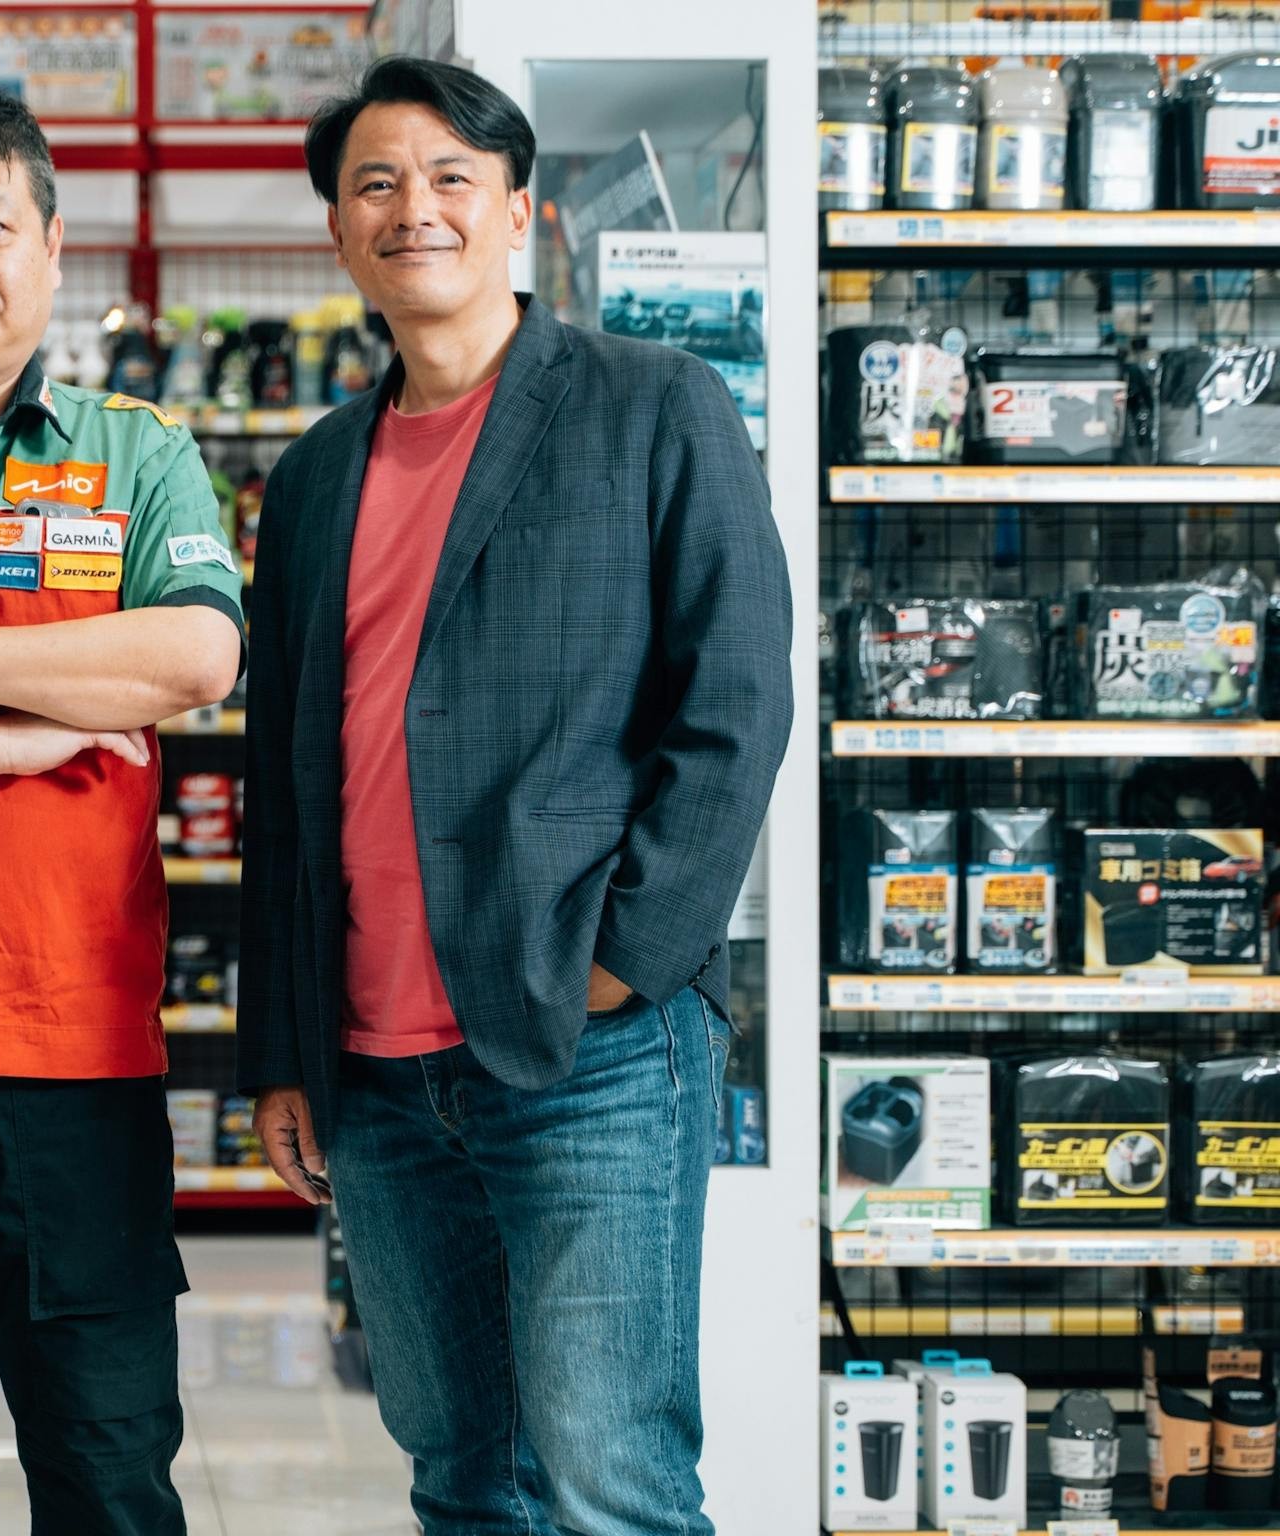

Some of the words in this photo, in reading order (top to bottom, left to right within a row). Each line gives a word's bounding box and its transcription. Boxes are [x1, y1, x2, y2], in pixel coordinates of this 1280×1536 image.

[52, 533, 113, 547] GARMIN
[62, 568, 116, 578] DUNLOP
[1095, 634, 1146, 684] 炭
